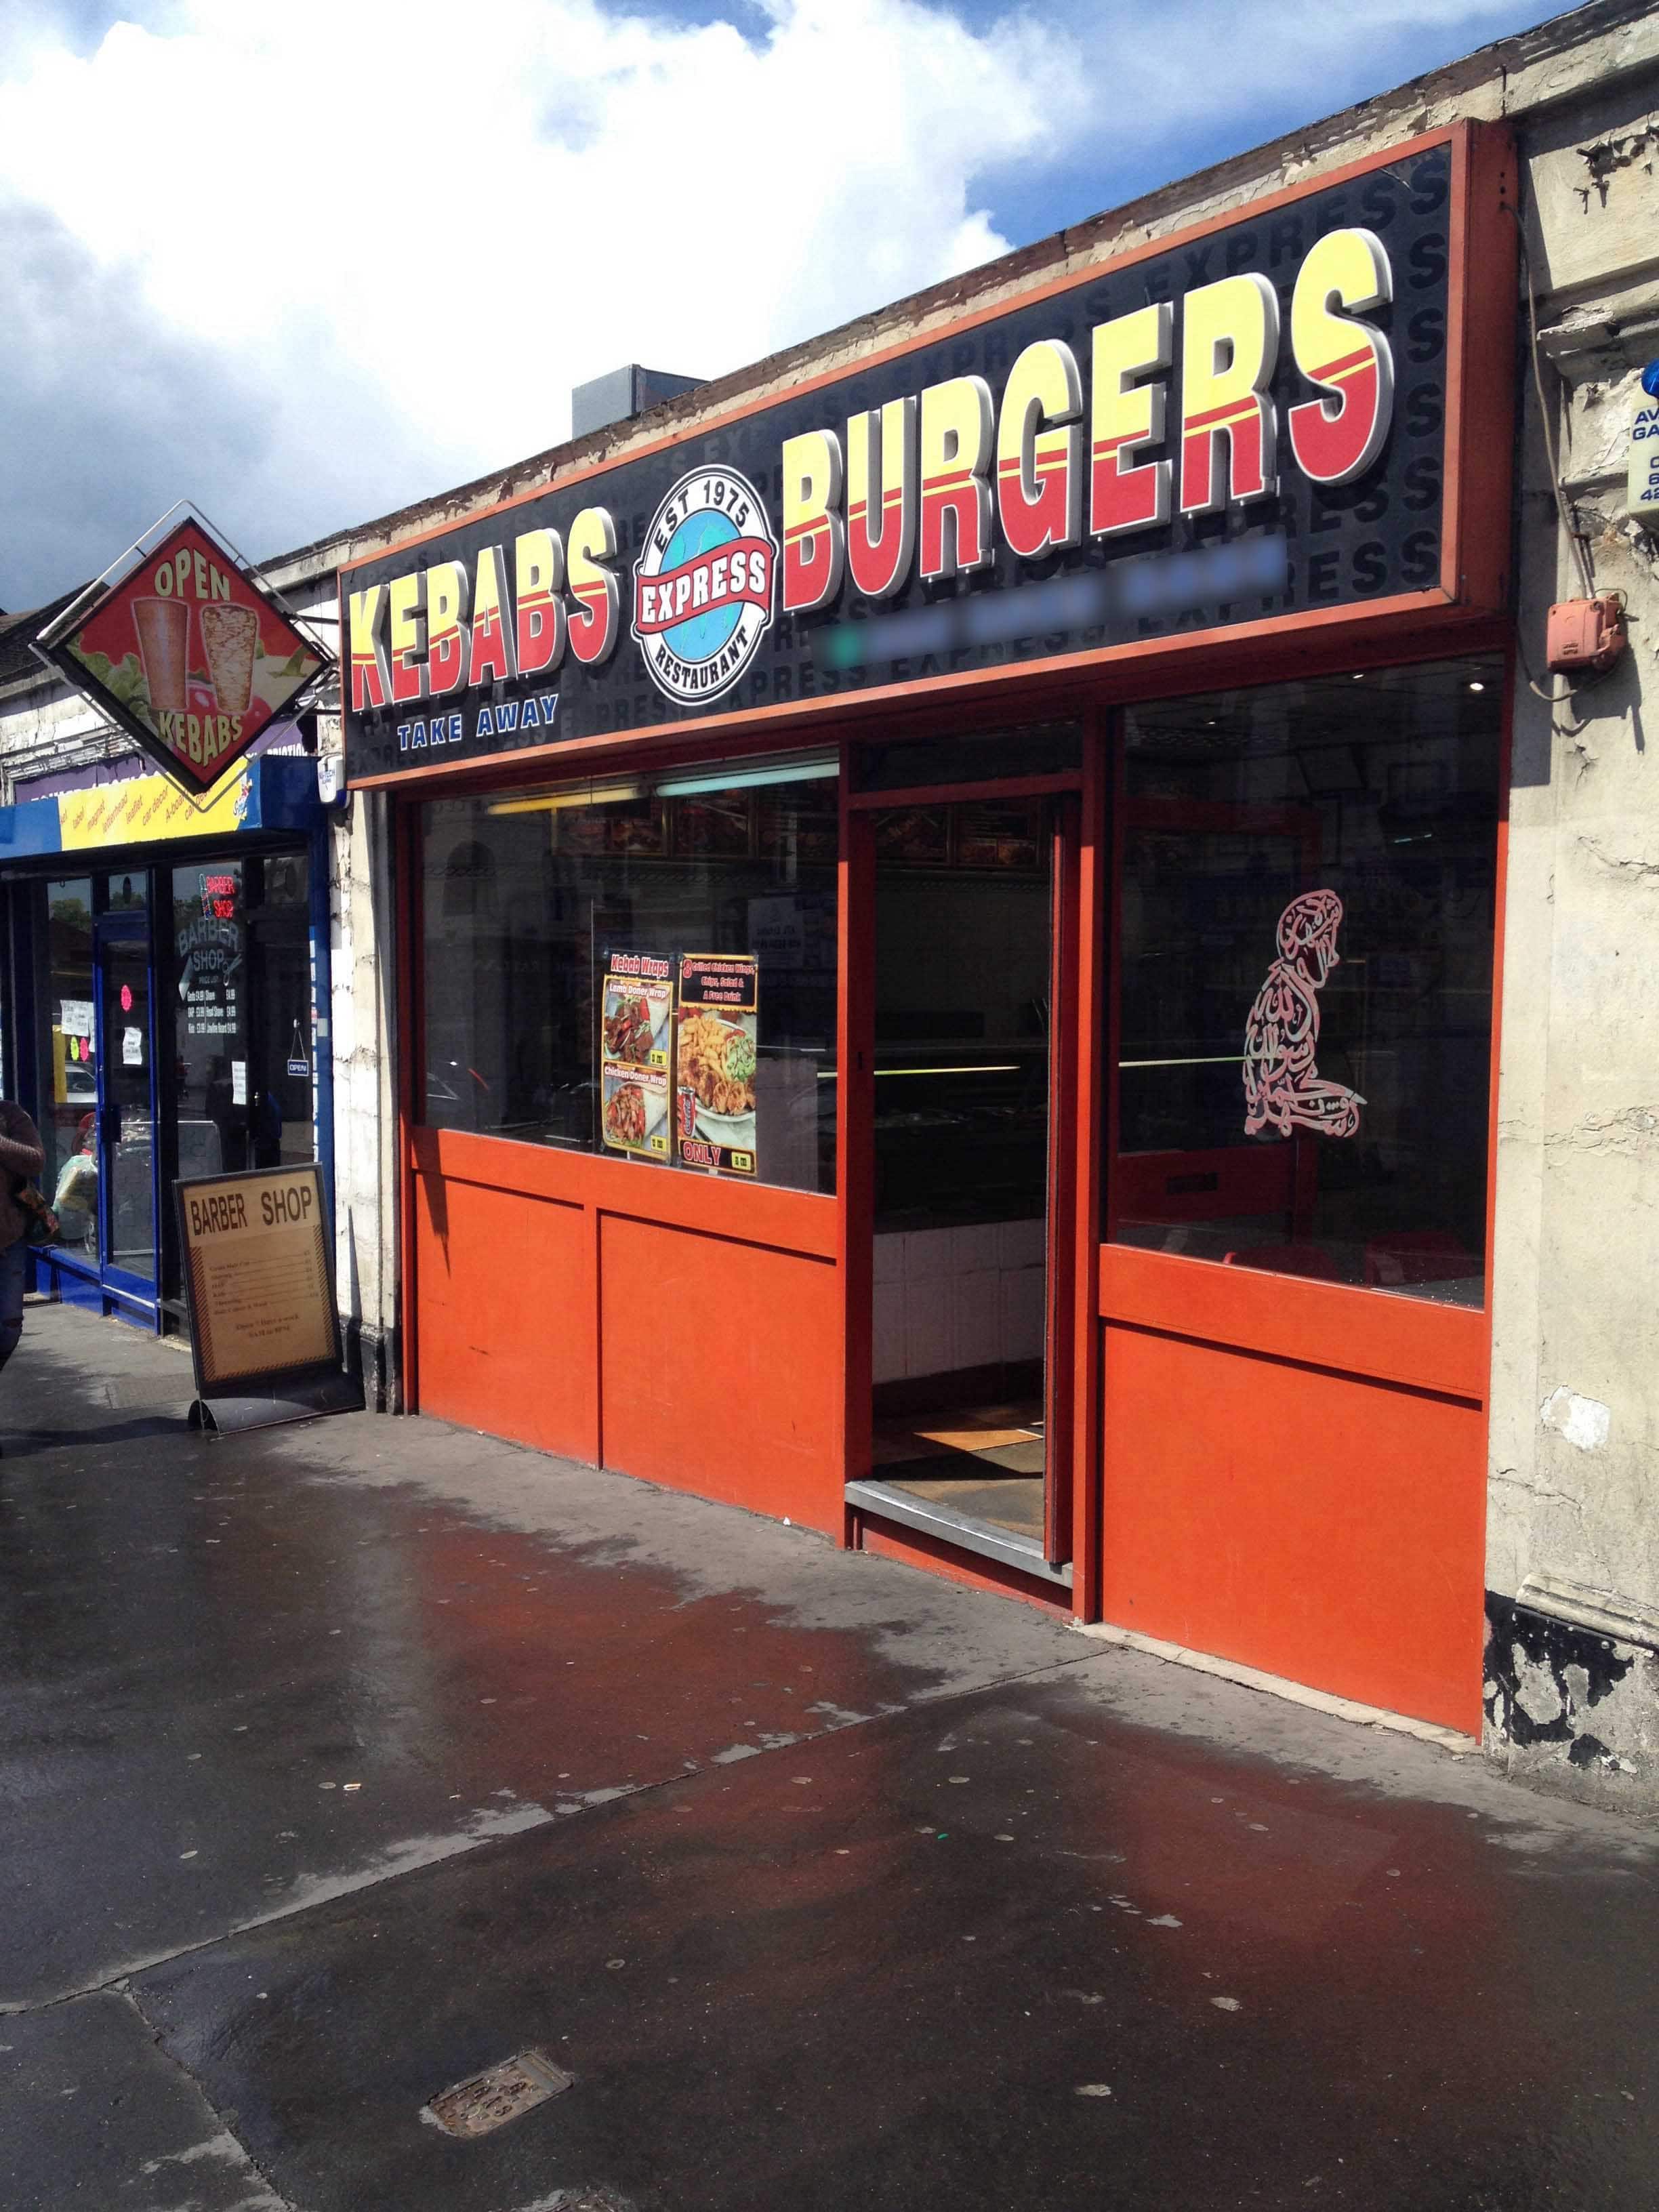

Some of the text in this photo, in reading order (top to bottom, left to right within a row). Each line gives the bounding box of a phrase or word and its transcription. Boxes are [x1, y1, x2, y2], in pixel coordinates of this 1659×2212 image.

[781, 228, 1395, 612] BURGERS
[1635, 409, 1659, 425] AV
[653, 491, 691, 554] EST
[703, 480, 750, 527] 1975
[155, 548, 230, 601] OPEN
[641, 551, 766, 624] EXPRESS
[348, 506, 620, 713] KEBABS
[655, 626, 750, 691] RESTAURANT
[159, 711, 244, 766] KEBABS
[396, 713, 464, 752] TAKE
[475, 693, 560, 738] AWAY
[178, 915, 239, 957] BARBER
[193, 949, 224, 972] SHOP
[611, 954, 669, 979] Kebab Wraps
[682, 958, 692, 979] 8
[692, 962, 711, 972] Grilled
[711, 962, 734, 973] Chicken
[609, 983, 667, 999] Lamb Doner Wrap
[709, 991, 723, 1001] Free
[720, 977, 738, 987] Salad
[289, 1063, 306, 1071] OPEN
[605, 1065, 667, 1088] Chicken Doner Wrap
[683, 1141, 721, 1166] ONLY
[190, 1186, 312, 1236] BARBER SHOP
